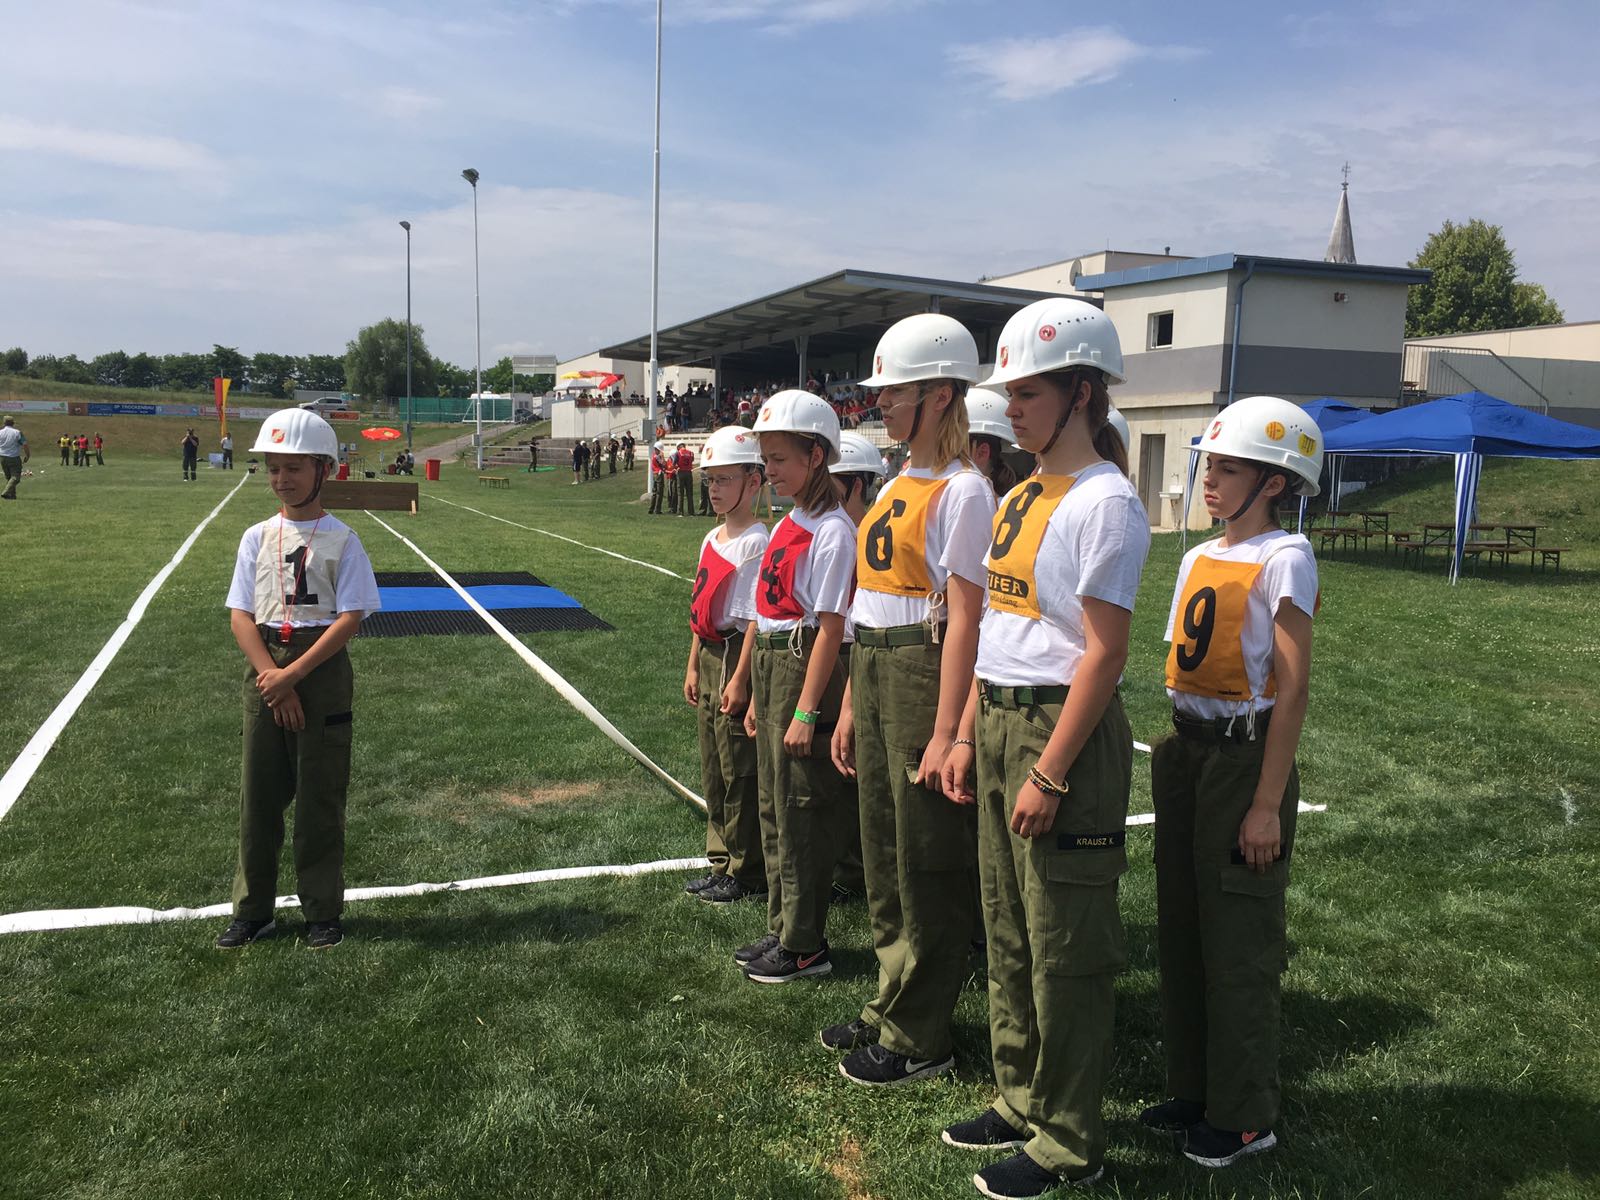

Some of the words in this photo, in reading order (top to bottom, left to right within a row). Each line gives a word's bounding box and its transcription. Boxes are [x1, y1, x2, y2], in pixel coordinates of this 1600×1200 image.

[866, 499, 907, 572] 6
[989, 480, 1043, 560] 8
[285, 545, 319, 606] 1
[987, 574, 1024, 595] IFER
[1176, 586, 1217, 672] 9
[1076, 837, 1107, 846] KRAUSZ
